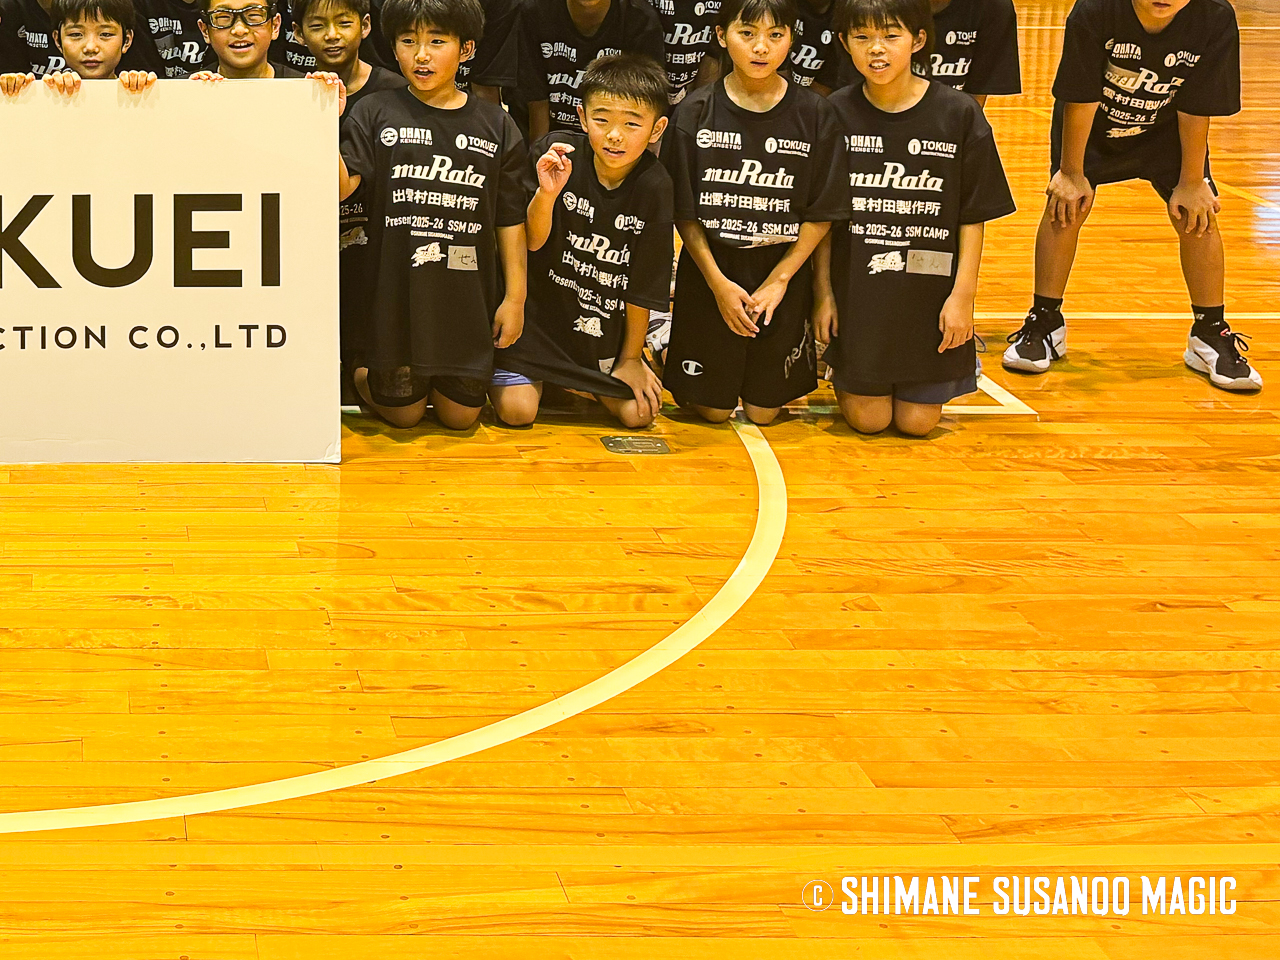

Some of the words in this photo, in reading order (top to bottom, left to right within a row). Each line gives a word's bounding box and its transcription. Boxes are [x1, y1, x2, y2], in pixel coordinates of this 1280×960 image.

[399, 127, 433, 141] OHATA
[850, 135, 883, 149] OHATA
[777, 138, 811, 153] TOKUEI
[921, 139, 957, 154] TOKUEI
[390, 154, 486, 189] muRata
[701, 158, 795, 190] muRata
[849, 161, 944, 193] muRata
[340, 201, 364, 217] 25-26
[851, 196, 942, 217] 雲村田製作所
[447, 220, 467, 233] SSM
[721, 219, 758, 232] 2025-26
[761, 222, 782, 235] SSM
[865, 223, 902, 238] 2025-26
[904, 225, 921, 238] SSM
[922, 226, 950, 240] CAMP
